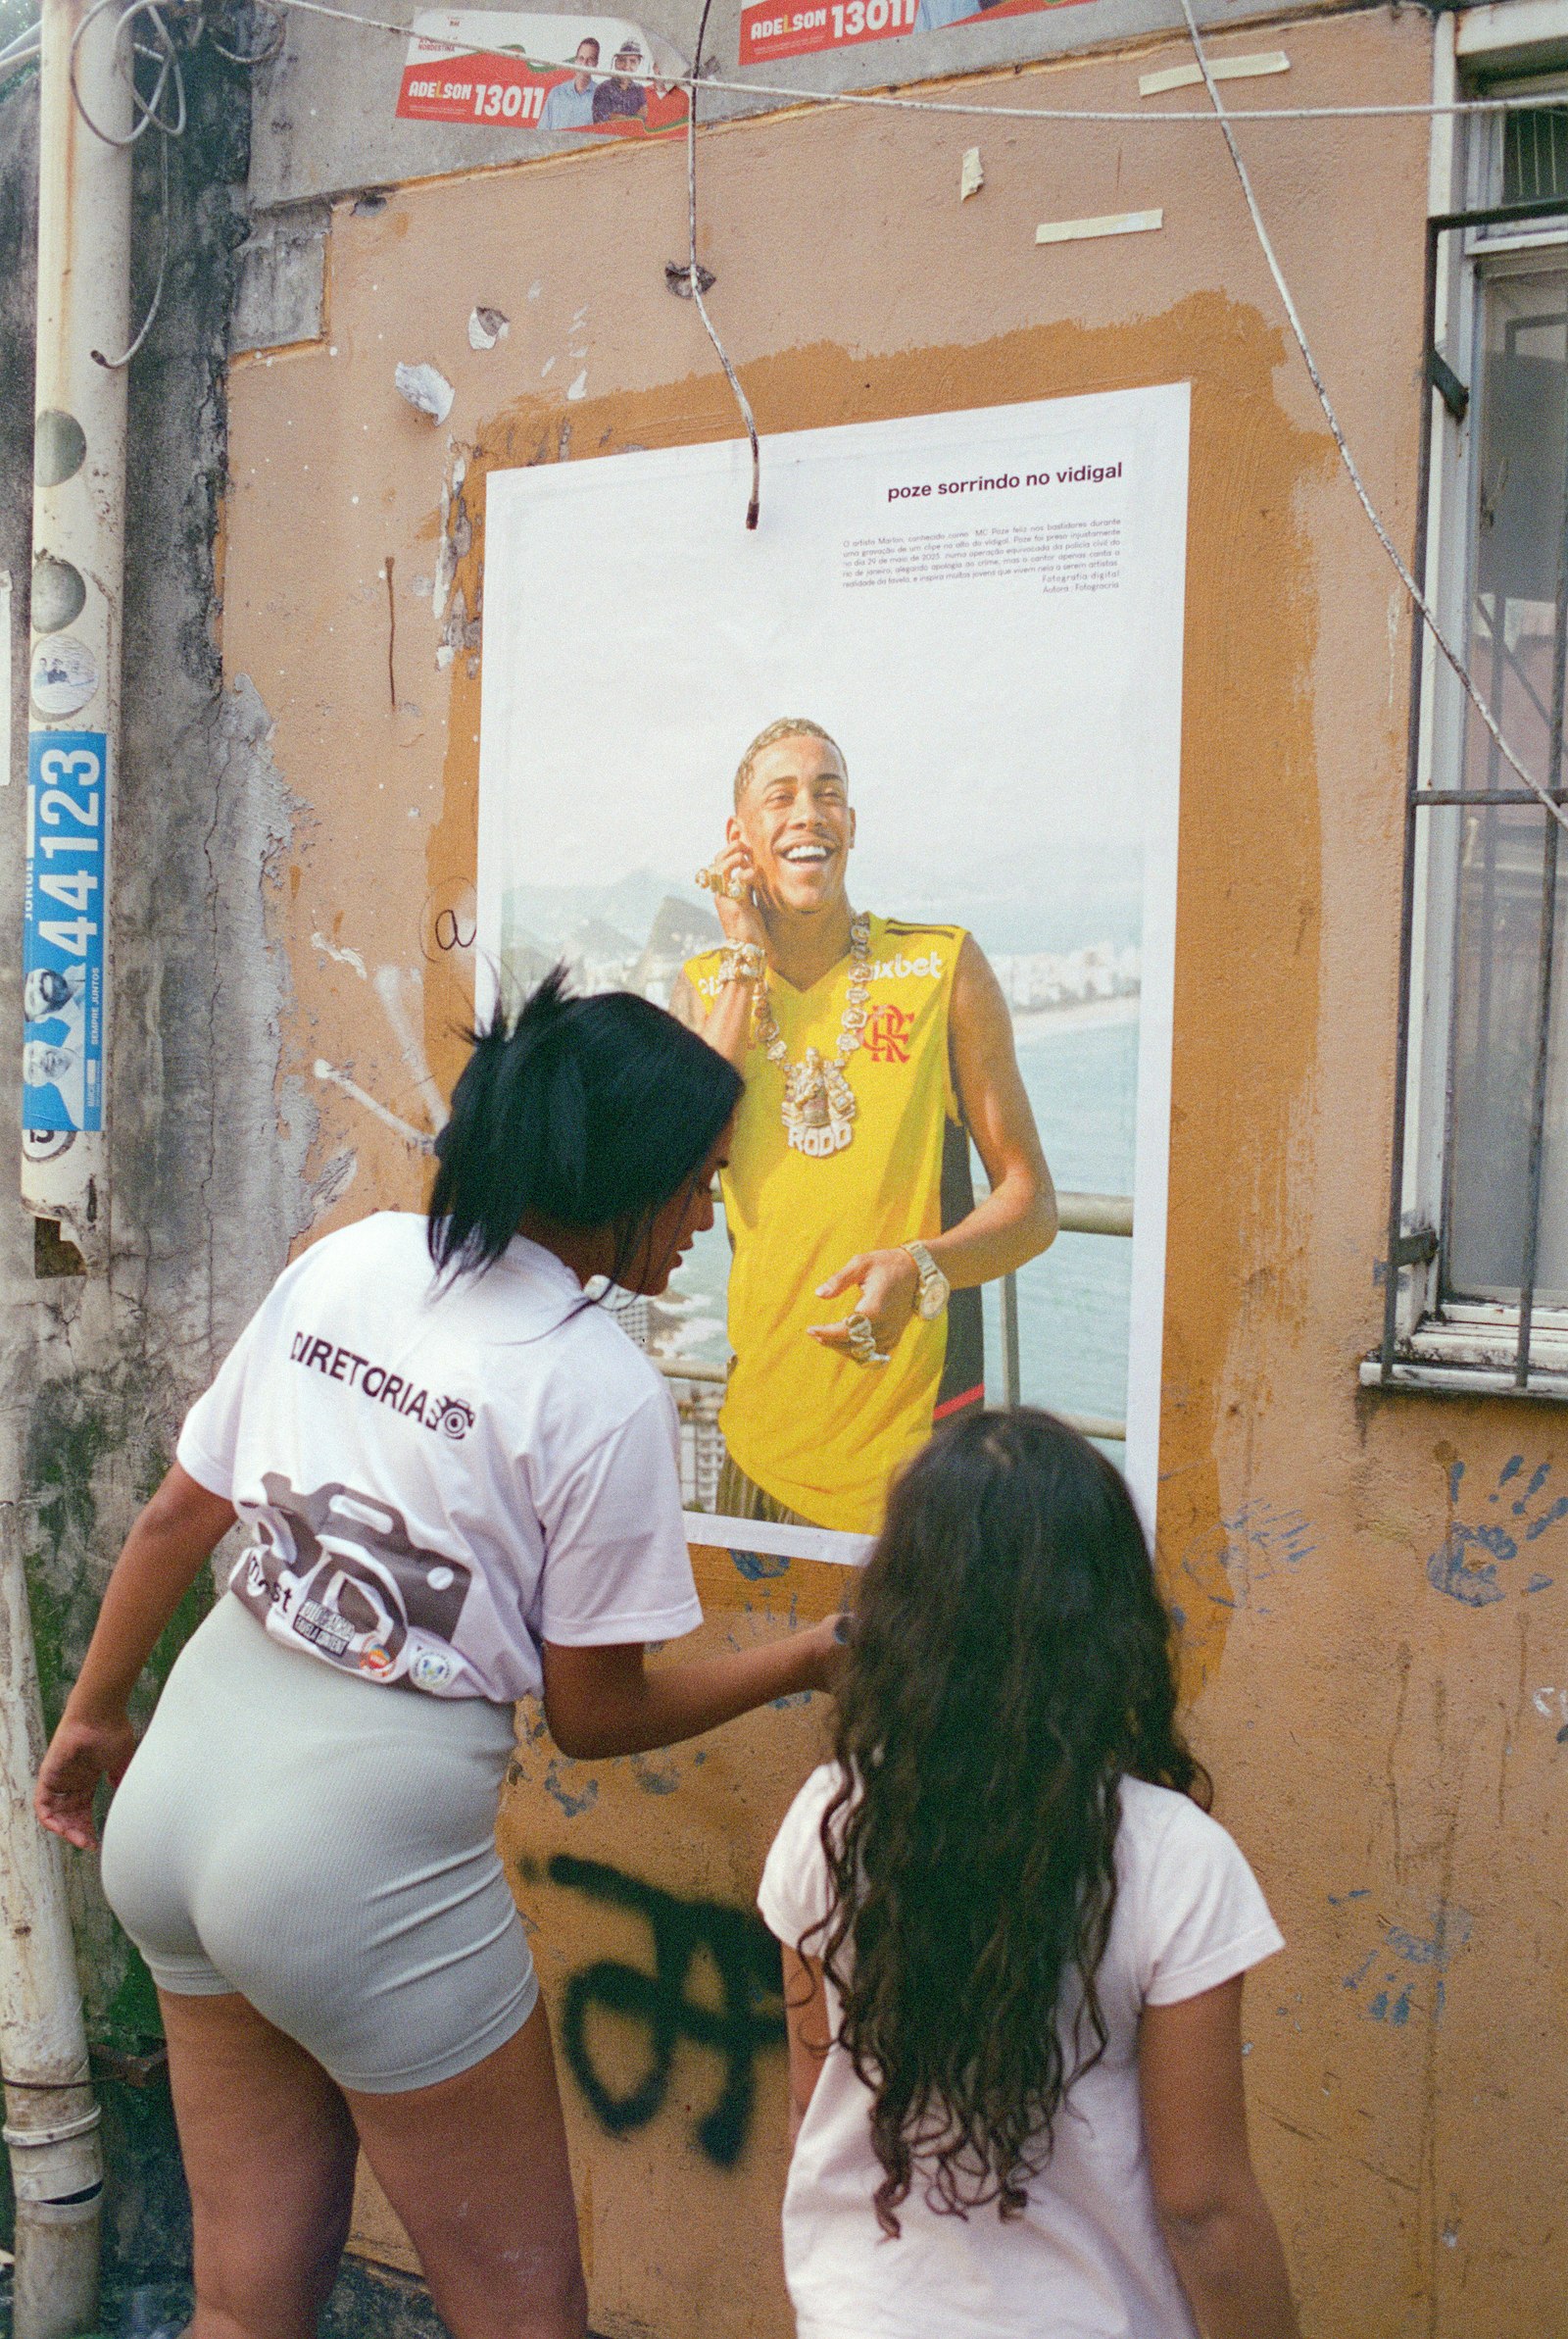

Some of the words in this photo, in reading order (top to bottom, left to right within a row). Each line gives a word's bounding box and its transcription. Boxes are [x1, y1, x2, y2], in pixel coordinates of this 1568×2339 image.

[751, 9, 827, 40] ADELSON
[831, 0, 916, 38] 13011
[408, 80, 472, 100] ADELSON
[474, 84, 545, 119] 13011
[887, 481, 932, 502] poze
[938, 473, 1020, 495] sorrindo
[1026, 472, 1050, 487] no
[1055, 462, 1123, 482] vidigal
[1047, 521, 1086, 529] bastidores
[1090, 518, 1120, 526] durante
[924, 542, 940, 551] clipe
[1070, 527, 1120, 539] injustamente
[895, 564, 927, 574] alegando
[931, 561, 961, 571] apologia
[1057, 552, 1085, 561] apenas
[1042, 572, 1087, 584] Fotografia
[1091, 569, 1118, 580] digital
[842, 578, 874, 587] realidade
[946, 571, 969, 579] muitos
[38, 747, 100, 957] 44123
[867, 950, 943, 980] ixbet
